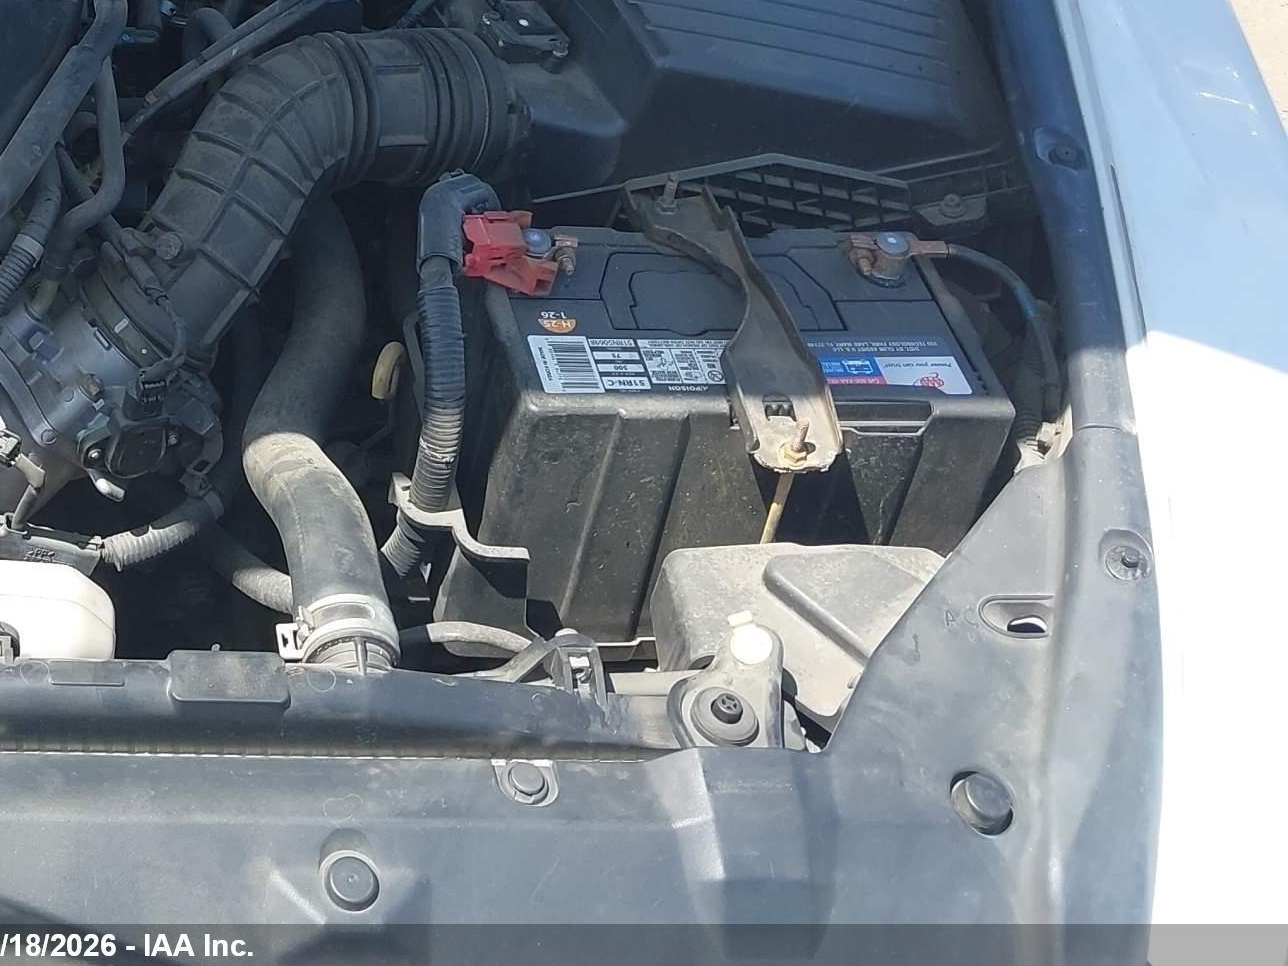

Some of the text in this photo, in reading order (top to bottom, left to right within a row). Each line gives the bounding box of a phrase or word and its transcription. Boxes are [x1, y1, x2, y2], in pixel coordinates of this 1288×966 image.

[540, 311, 567, 319] 1-26
[543, 320, 572, 328] H-25
[607, 379, 646, 387] 51RN-C
